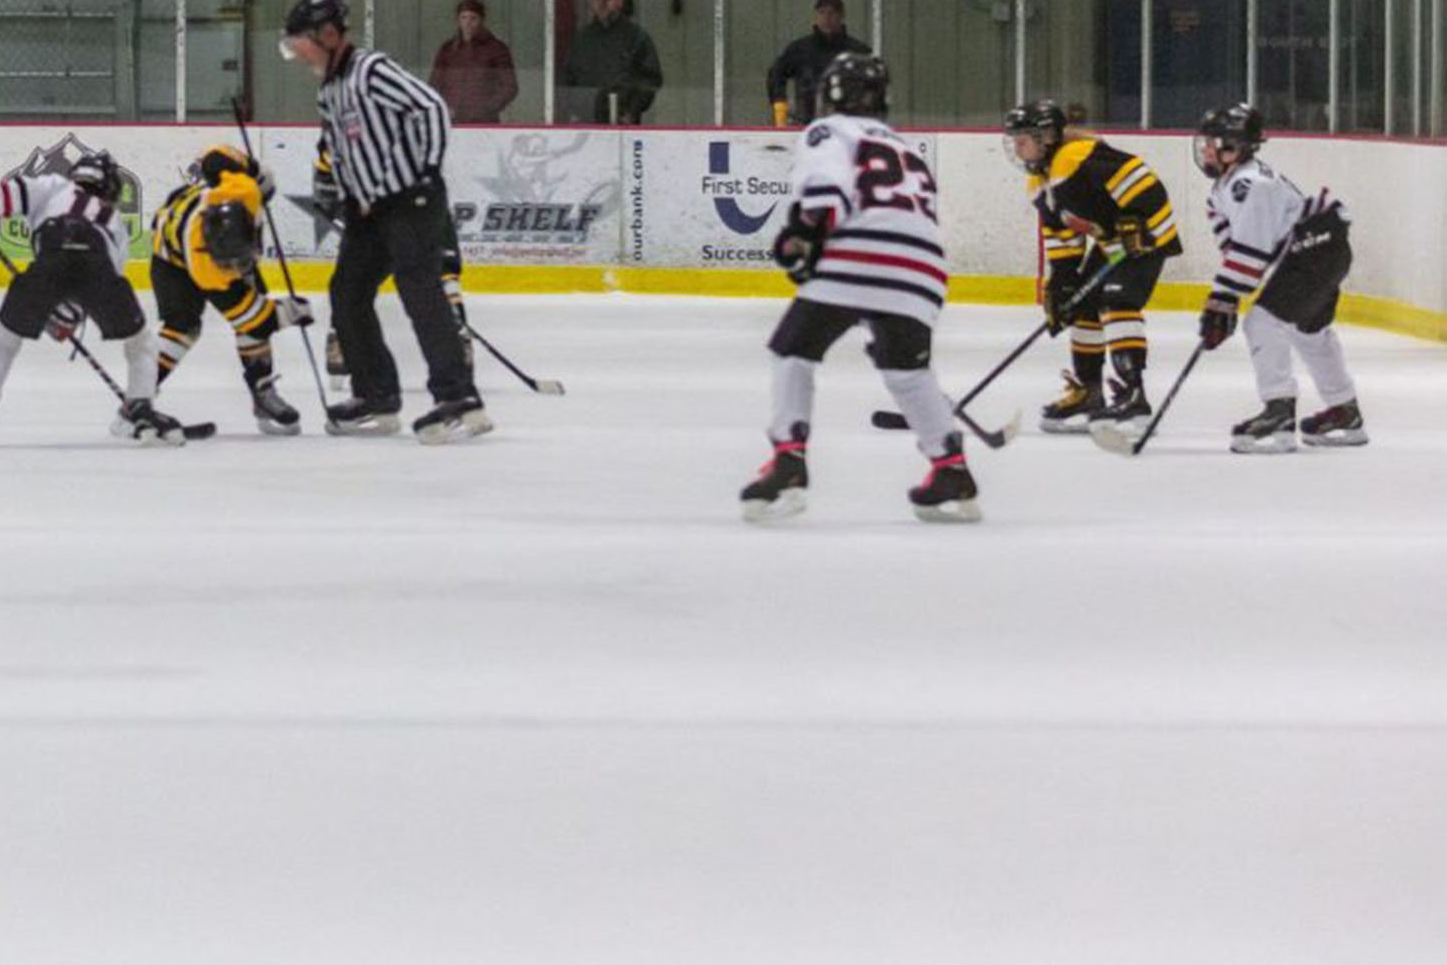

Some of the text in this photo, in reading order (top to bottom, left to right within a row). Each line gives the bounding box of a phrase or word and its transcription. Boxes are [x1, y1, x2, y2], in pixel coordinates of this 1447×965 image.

[630, 139, 643, 262] ourbank.com
[702, 176, 744, 195] First
[856, 139, 938, 225] 23
[482, 202, 602, 232] SHELF
